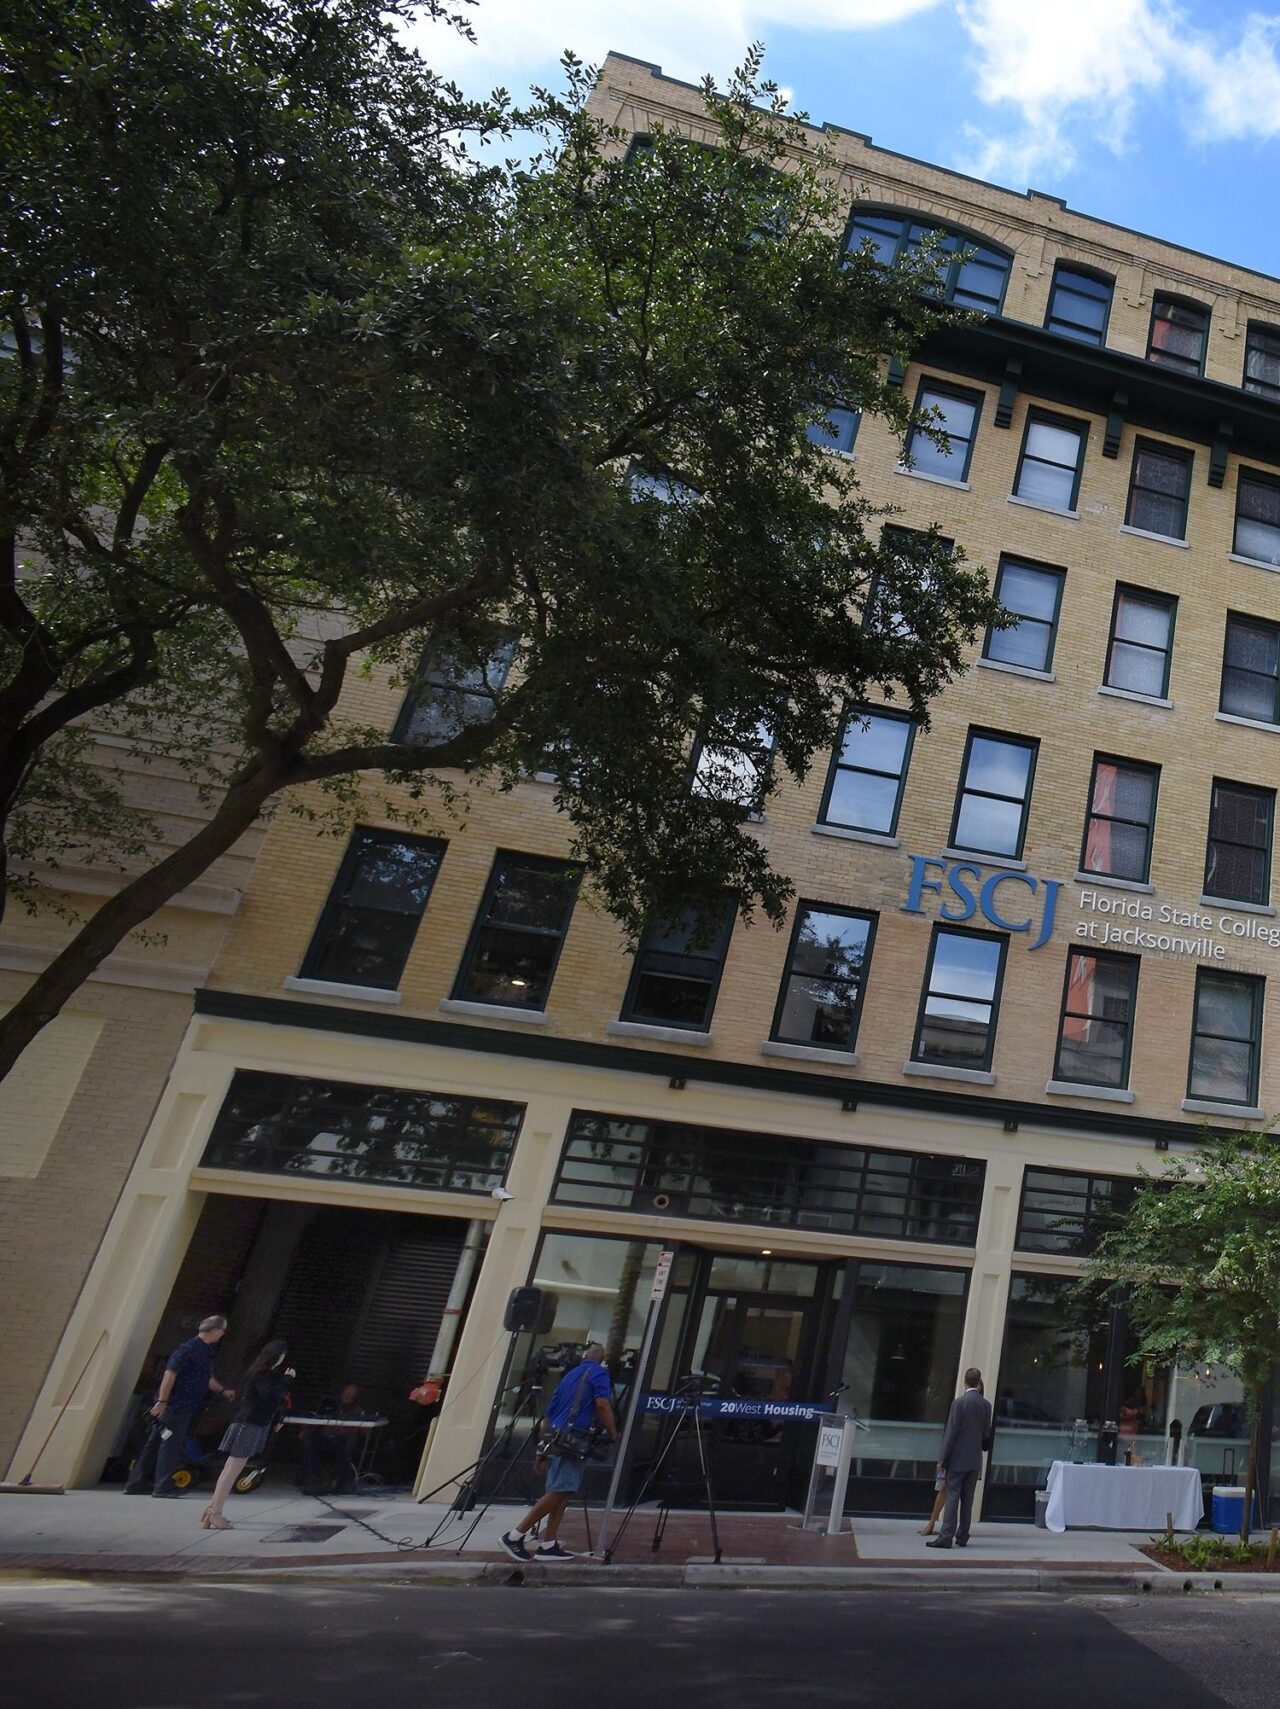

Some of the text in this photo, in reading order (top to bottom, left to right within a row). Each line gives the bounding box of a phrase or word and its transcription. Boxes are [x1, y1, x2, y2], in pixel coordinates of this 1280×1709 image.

[900, 855, 1064, 951] FSCJ
[1079, 891, 1153, 920] Florida
[1159, 905, 1213, 930] State
[1075, 920, 1226, 960] at Jacksonville
[646, 1397, 676, 1413] FSCJ
[720, 1402, 761, 1415] 20West
[764, 1404, 814, 1419] Housing
